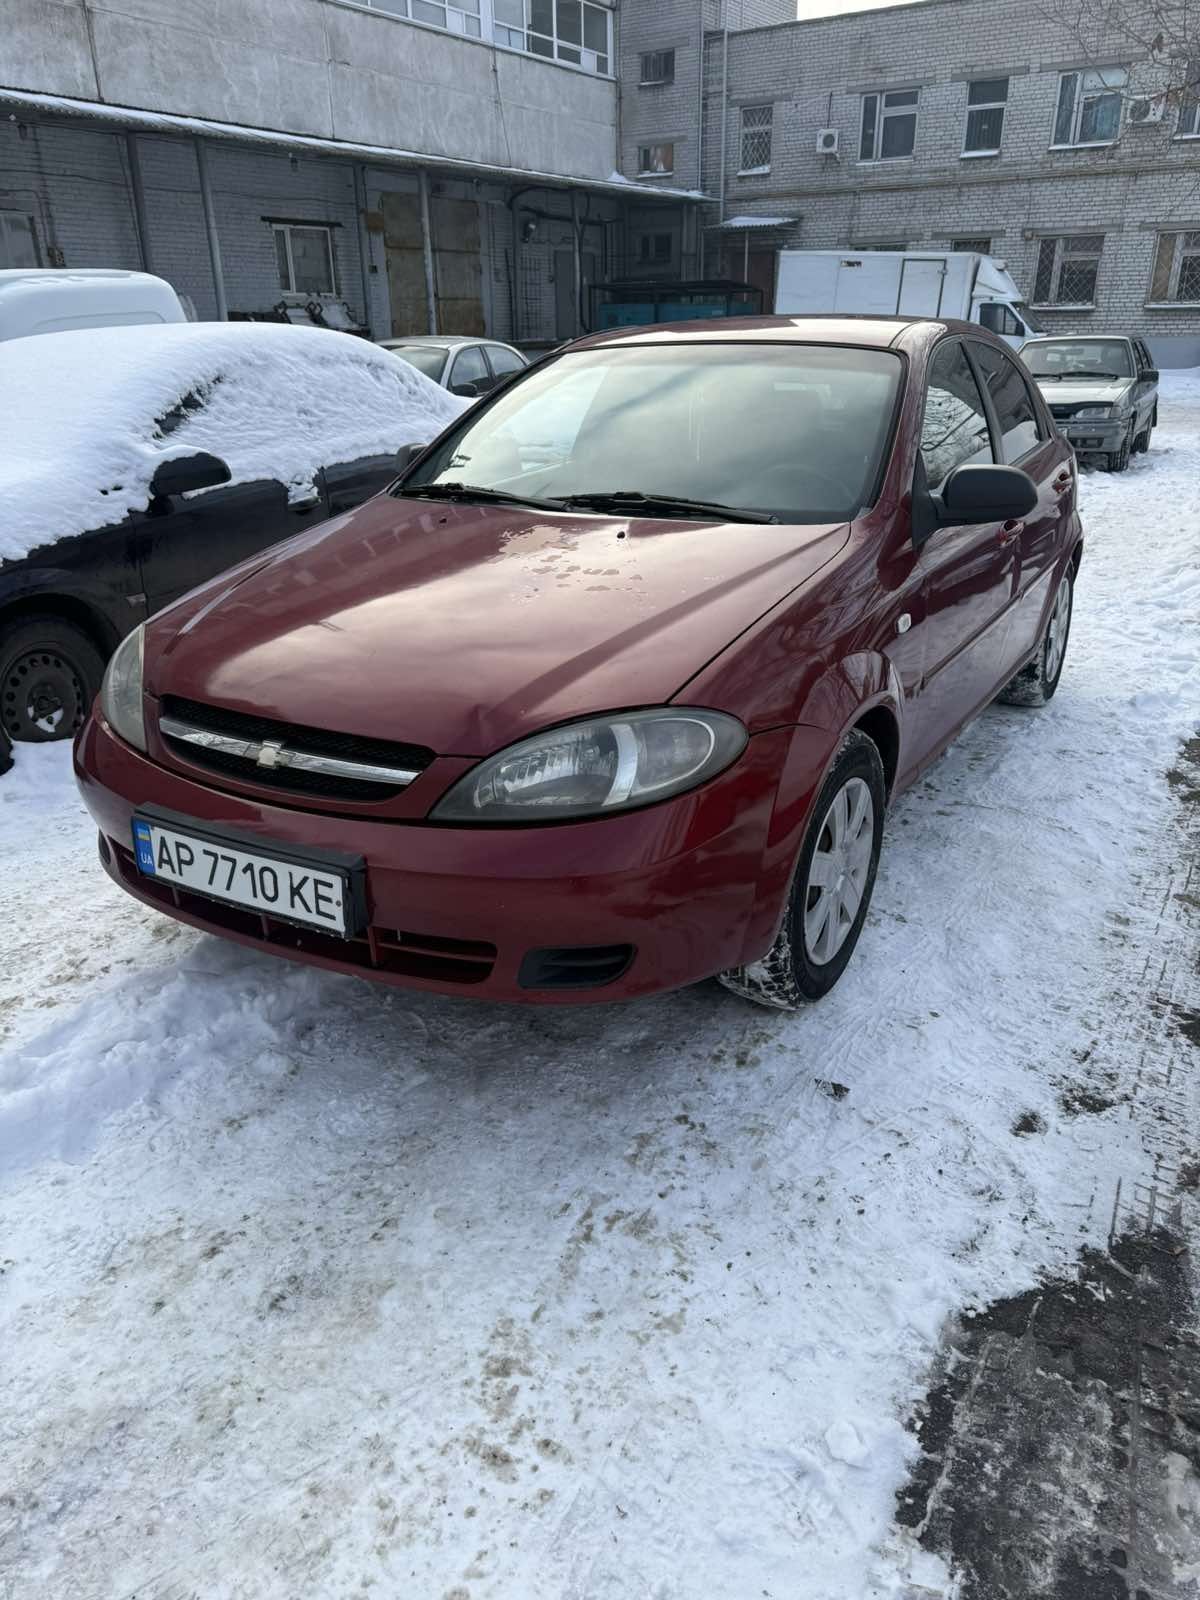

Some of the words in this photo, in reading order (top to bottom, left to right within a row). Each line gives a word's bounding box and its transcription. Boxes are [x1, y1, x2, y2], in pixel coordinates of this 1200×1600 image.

[140, 852, 154, 865] UA
[158, 836, 194, 877] AP
[203, 849, 279, 903] 7710
[288, 871, 336, 921] KE
